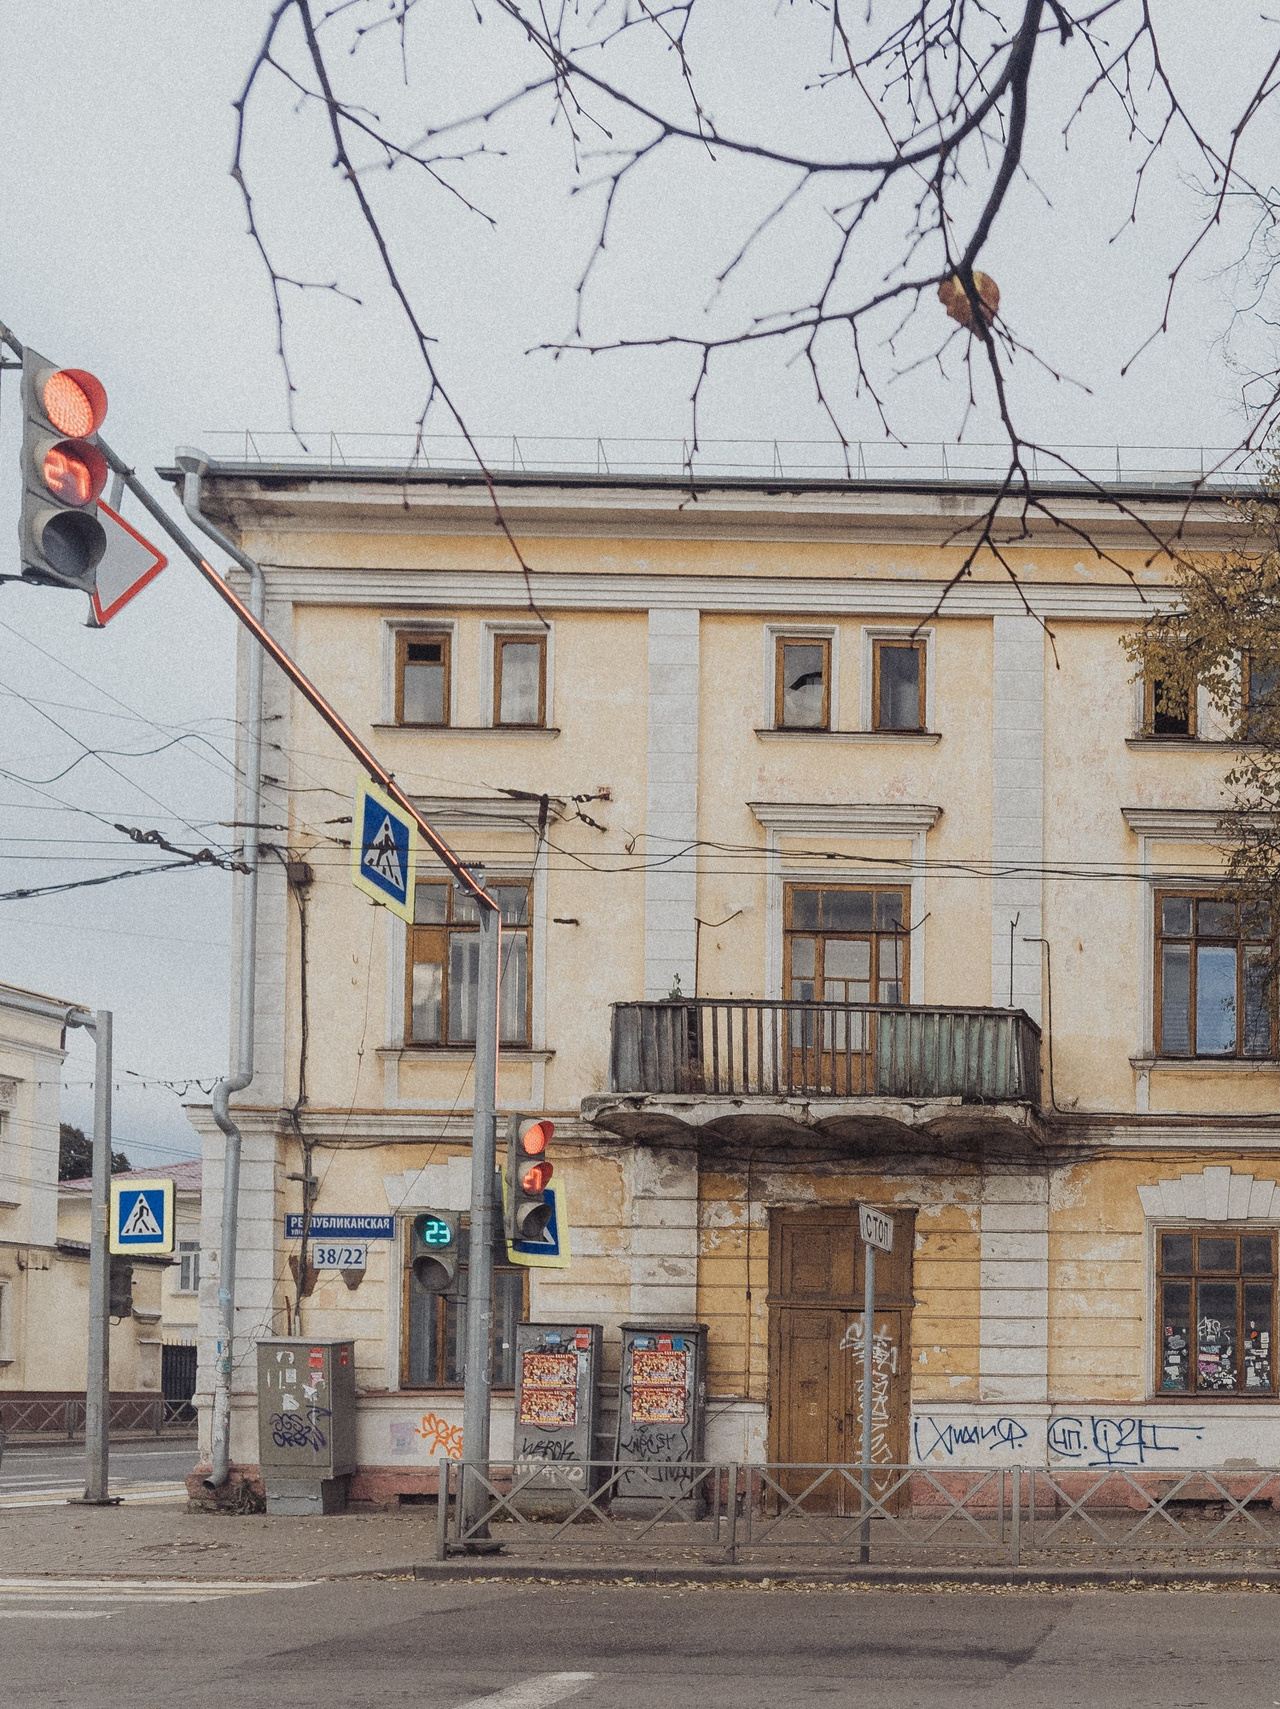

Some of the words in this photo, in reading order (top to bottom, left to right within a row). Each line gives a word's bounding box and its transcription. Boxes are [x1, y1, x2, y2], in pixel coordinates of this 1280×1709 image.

[290, 1216, 390, 1229] РЕПУБЛИКАНСКАЯ
[425, 1221, 450, 1244] 23
[865, 1213, 889, 1246] СТОП
[317, 1248, 363, 1265] 38/22
